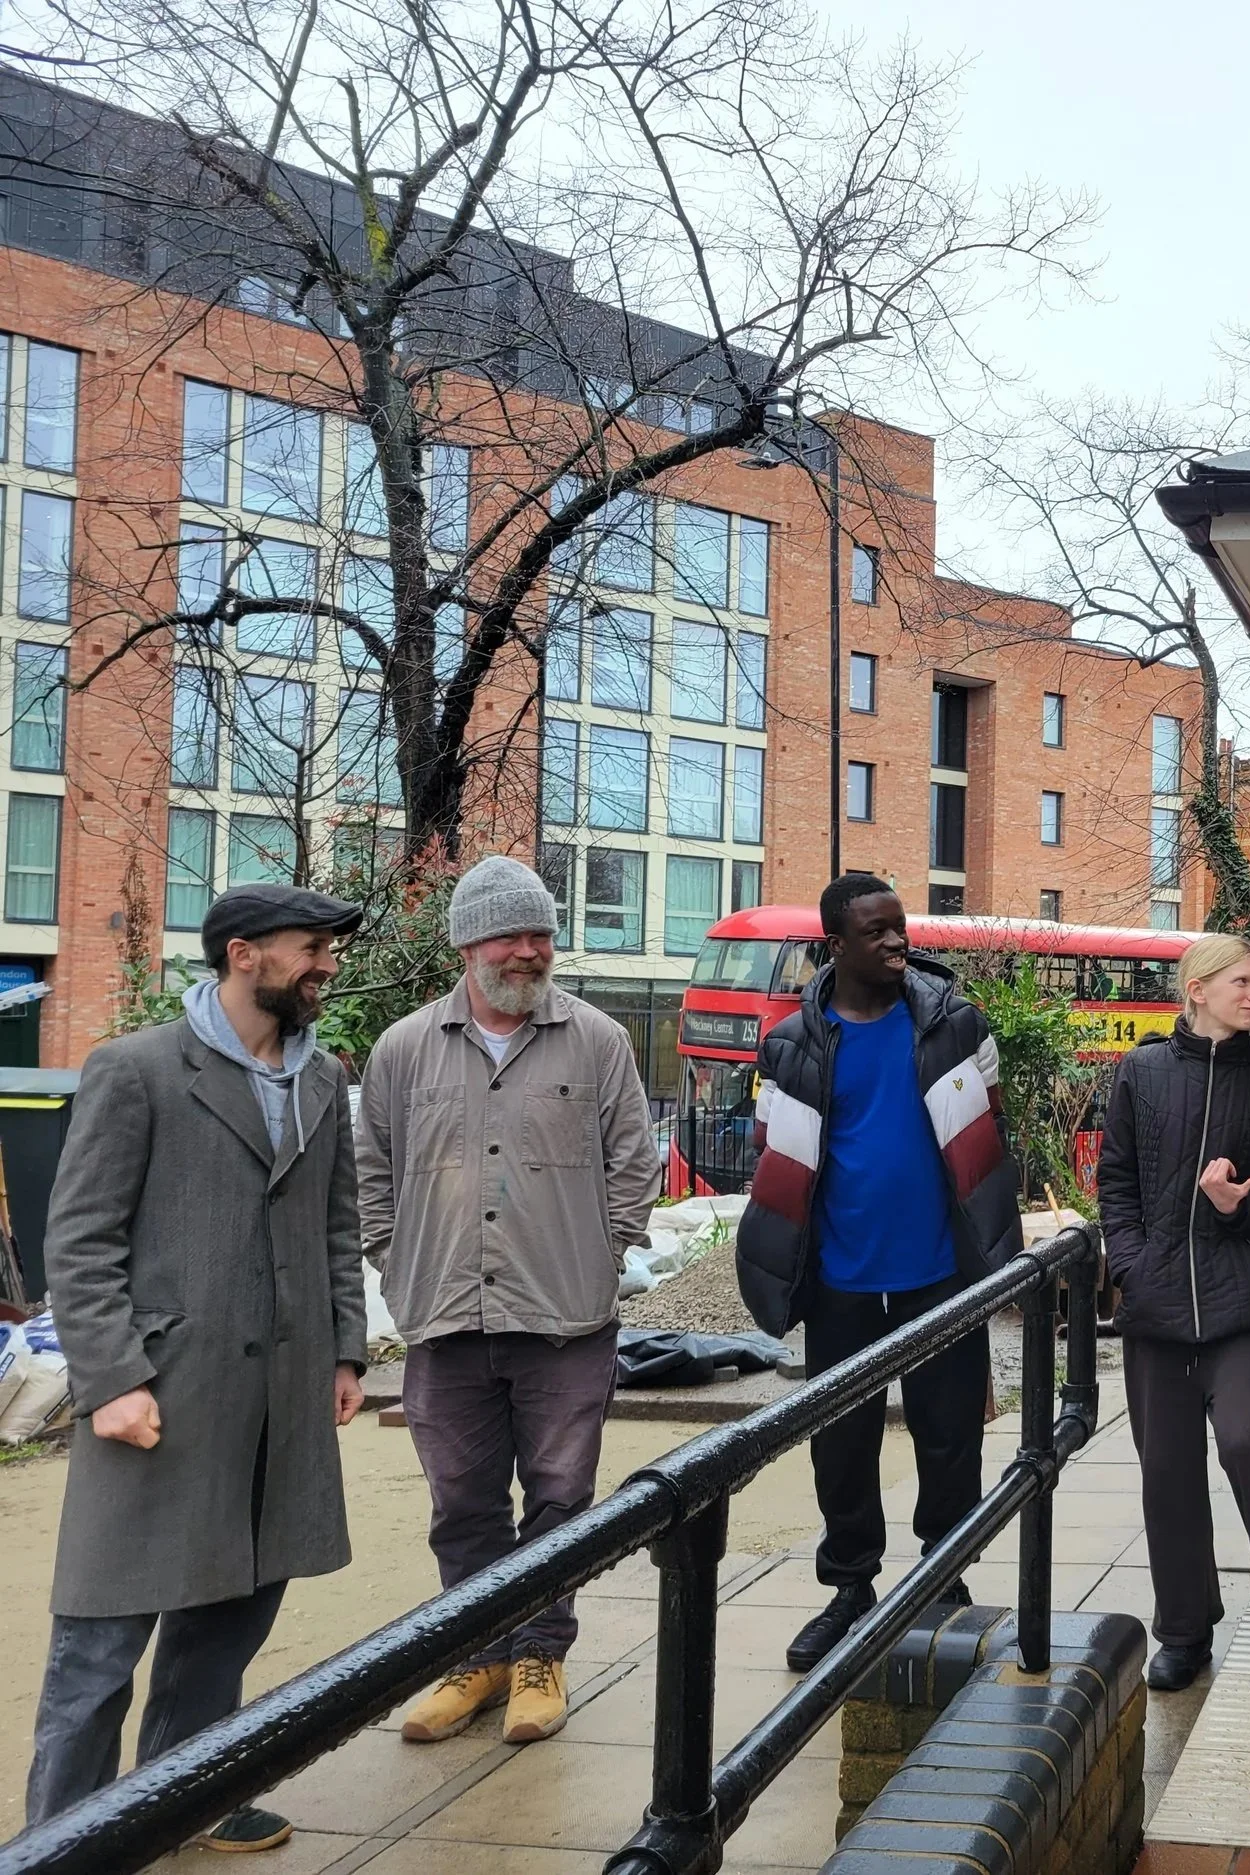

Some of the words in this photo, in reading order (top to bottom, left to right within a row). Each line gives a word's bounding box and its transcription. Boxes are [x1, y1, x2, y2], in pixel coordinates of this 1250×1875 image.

[690, 1018, 712, 1035] Hackney
[713, 1020, 734, 1035] Central
[742, 1020, 758, 1042] 253
[1113, 1020, 1136, 1042] 14
